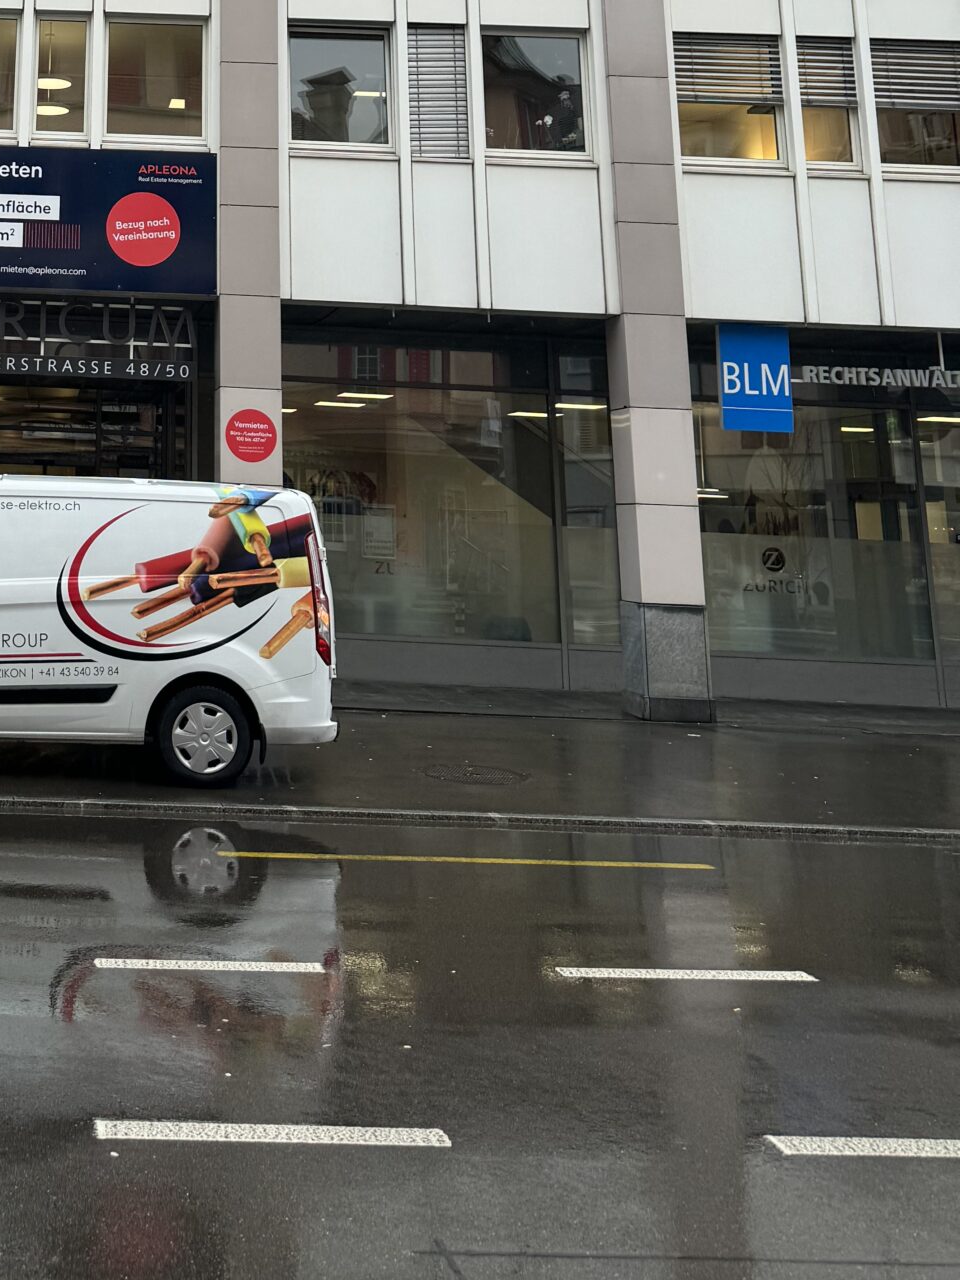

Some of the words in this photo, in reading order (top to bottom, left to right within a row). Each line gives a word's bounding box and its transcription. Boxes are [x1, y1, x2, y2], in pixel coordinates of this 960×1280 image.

[138, 164, 197, 176] APLEONA
[115, 221, 145, 230] Bezug
[147, 216, 170, 227] nach
[112, 230, 175, 241] Vereinbarung
[0, 265, 87, 276] mieten@apleona.com
[126, 363, 190, 378] 48/50
[723, 361, 790, 396] BLM
[234, 421, 269, 429] Vermieten
[0, 500, 81, 511] se-elektro.ch
[38, 667, 56, 678] +41
[59, 667, 72, 678] 43
[73, 666, 92, 677] 540
[93, 666, 106, 676] 39
[107, 666, 120, 676] 84
